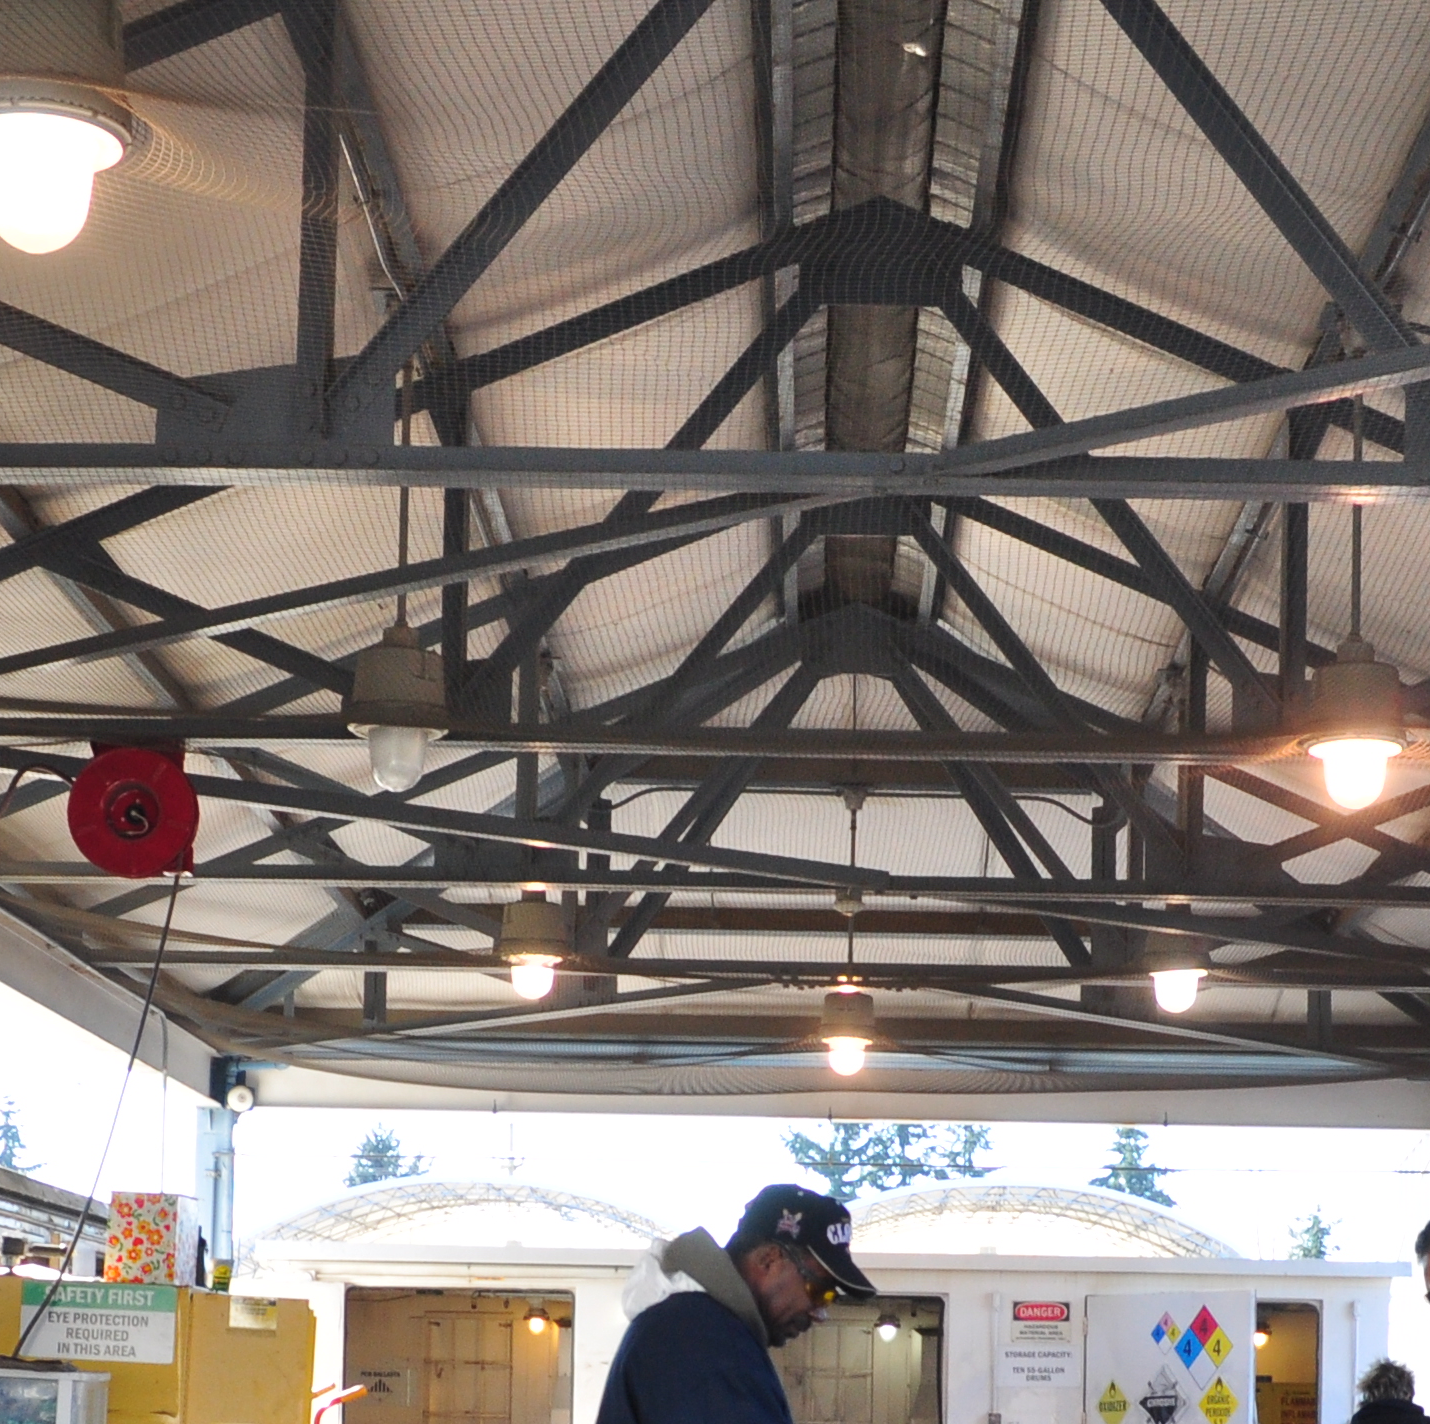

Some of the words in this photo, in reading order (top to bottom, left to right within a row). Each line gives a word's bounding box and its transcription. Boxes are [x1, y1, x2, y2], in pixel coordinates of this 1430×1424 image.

[43, 1285, 105, 1304] SAFETY
[108, 1289, 154, 1306] FIRST
[48, 1311, 70, 1323] EYE
[73, 1313, 149, 1327] PROTECTION
[1019, 1307, 1061, 1317] DANGER
[66, 1327, 129, 1341] REQUIRED
[1200, 1318, 1208, 1336] 4
[57, 1343, 71, 1354] IN
[74, 1344, 101, 1356] THIS
[104, 1346, 136, 1358] AREA
[1183, 1339, 1192, 1356] 4
[1213, 1339, 1221, 1356] 4
[1099, 1402, 1127, 1412] OXIDIZER
[1207, 1396, 1230, 1405] ORGANIC
[1206, 1408, 1231, 1417] PEROXIDE
